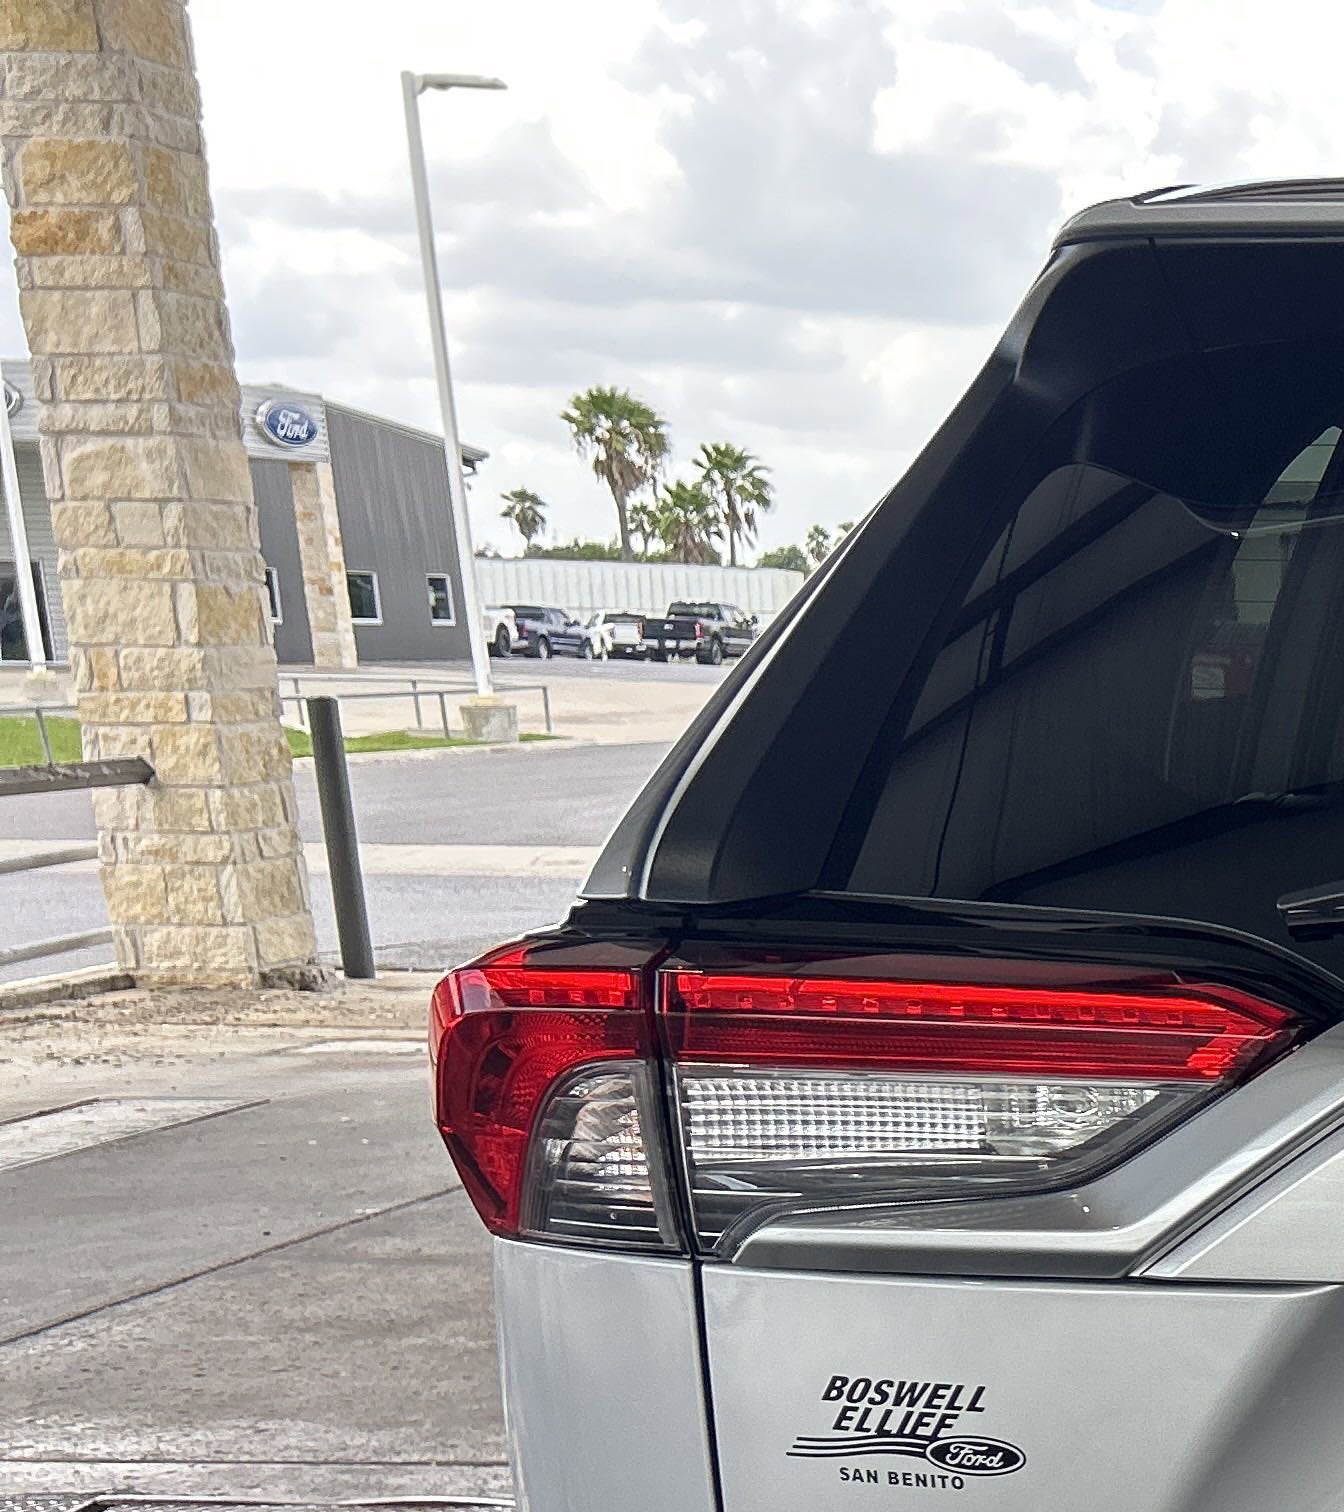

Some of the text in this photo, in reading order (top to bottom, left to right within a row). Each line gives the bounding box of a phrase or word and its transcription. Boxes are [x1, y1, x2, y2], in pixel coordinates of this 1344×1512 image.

[821, 1375, 986, 1412] BOSWELL
[832, 1406, 959, 1438] ELLIFF
[946, 1443, 1004, 1468] Ford
[839, 1467, 965, 1490] SAN BENITO
